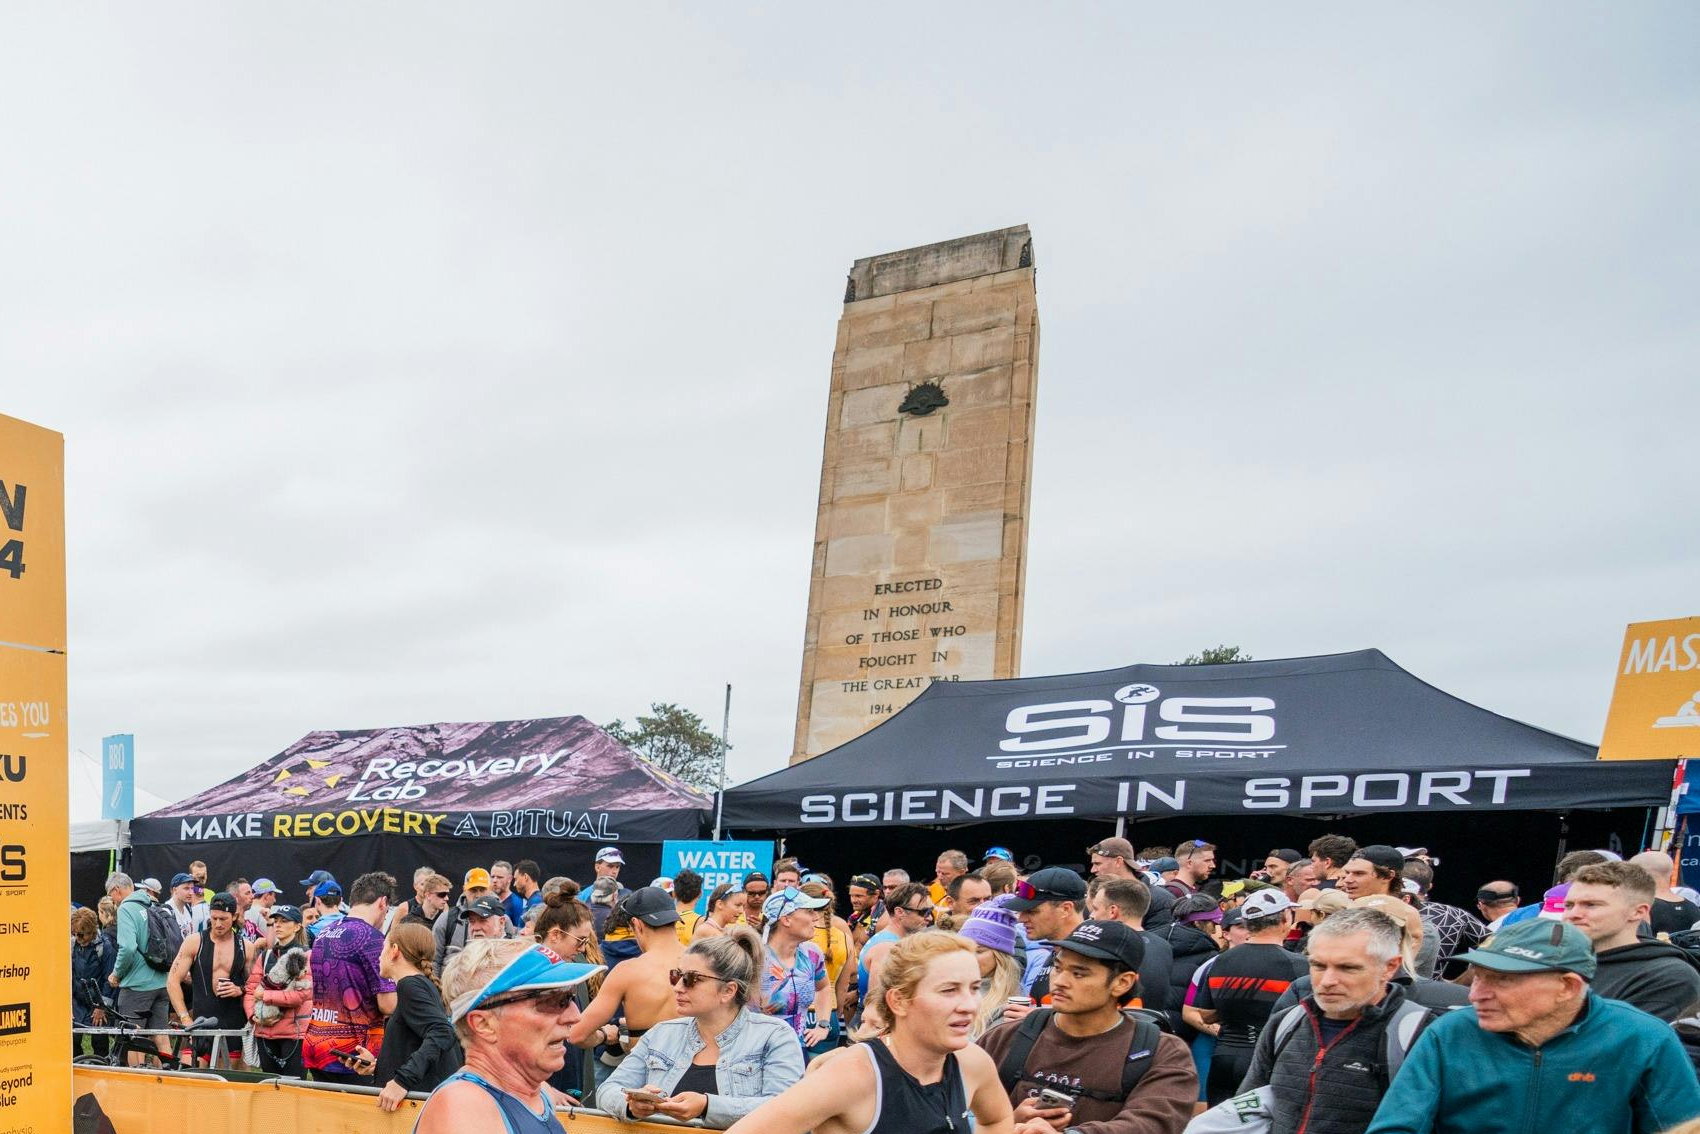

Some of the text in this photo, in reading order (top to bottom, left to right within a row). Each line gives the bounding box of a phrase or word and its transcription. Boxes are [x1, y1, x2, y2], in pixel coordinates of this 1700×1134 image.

[874, 578, 943, 595] ERECTED
[863, 601, 954, 621] IN HONOUR
[845, 625, 967, 645] OF THOSE WHO
[859, 651, 948, 669] FOUGHT IN
[1623, 632, 1700, 675] MAS
[841, 680, 868, 692] THE
[873, 676, 923, 691] GREAT
[19, 701, 50, 728] YOU
[870, 703, 893, 714] 1914
[998, 683, 1277, 752] SiS
[360, 748, 571, 781] Recovery
[995, 750, 1277, 769] SCIENCE IN SPORT
[346, 778, 427, 801] Lab
[799, 768, 1532, 824] SCIENCE IN SPORT
[179, 808, 620, 841] MAKE RECOVERY A RITUAL
[677, 850, 757, 869] WATER
[1502, 945, 1544, 960] 2XU
[310, 1007, 339, 1025] RADIE
[10, 1063, 33, 1073] supporting
[1567, 1071, 1597, 1083] dhb
